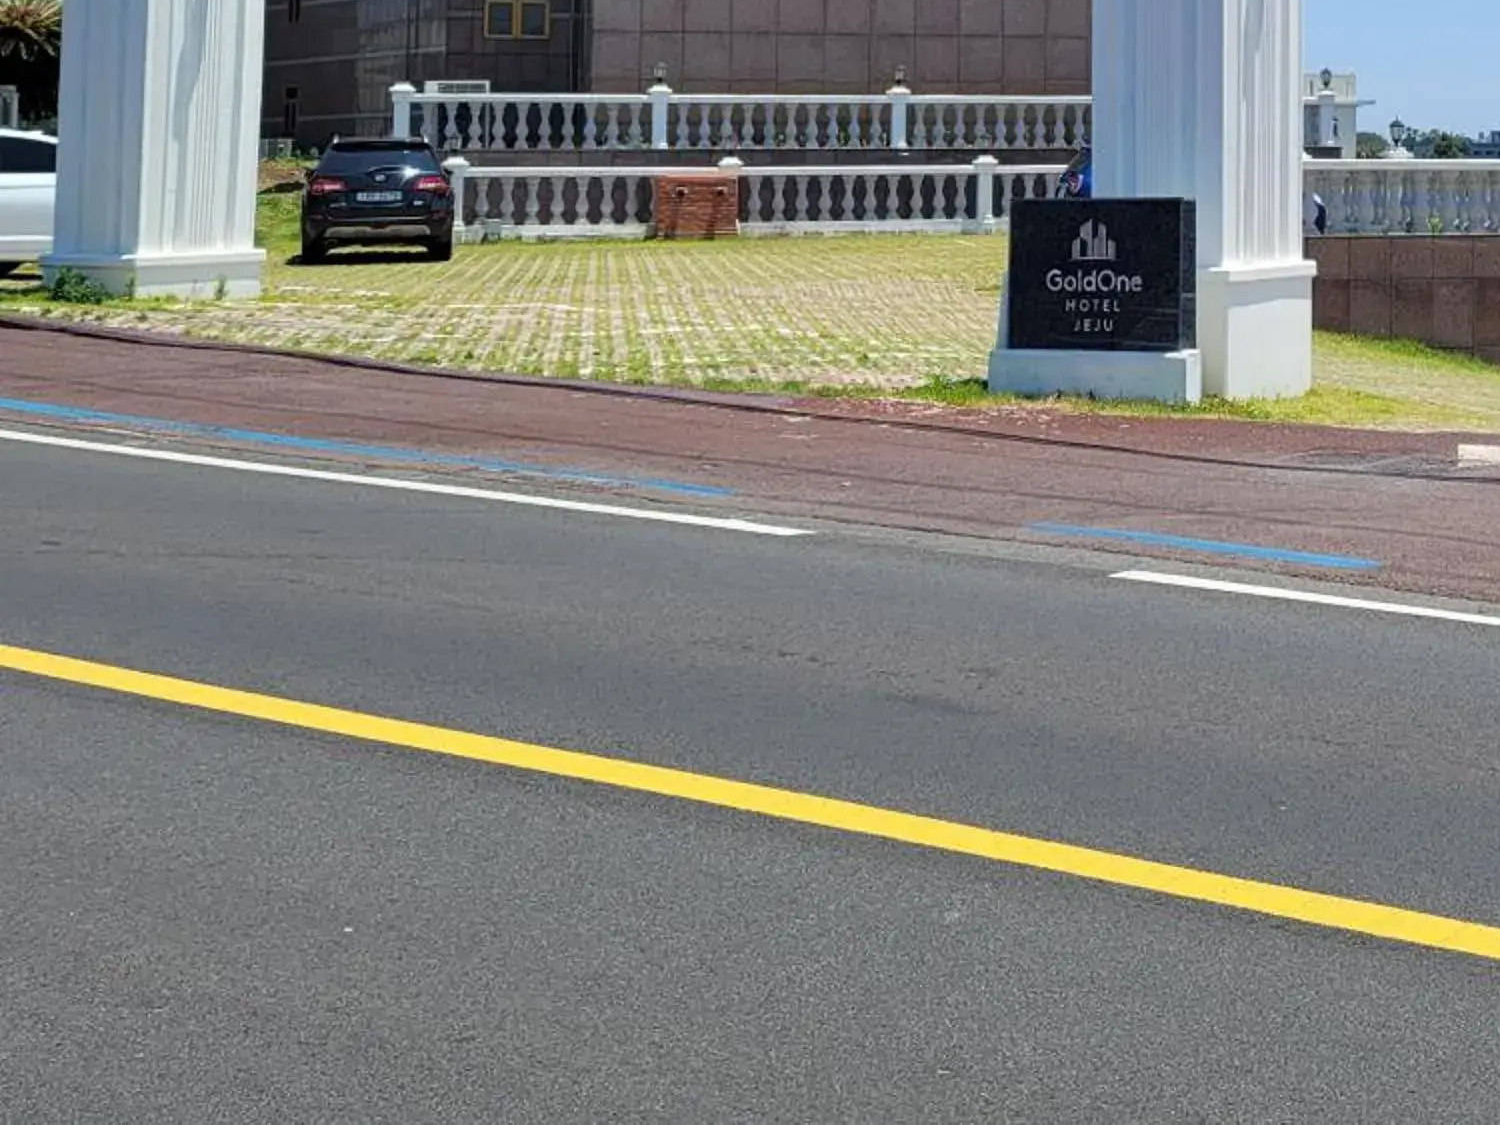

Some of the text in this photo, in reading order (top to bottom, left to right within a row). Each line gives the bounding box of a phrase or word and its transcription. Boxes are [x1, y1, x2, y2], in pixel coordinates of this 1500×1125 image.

[1046, 269, 1142, 292] GoldOne
[1065, 298, 1121, 312] HOTEL
[1074, 318, 1113, 332] JEJU
